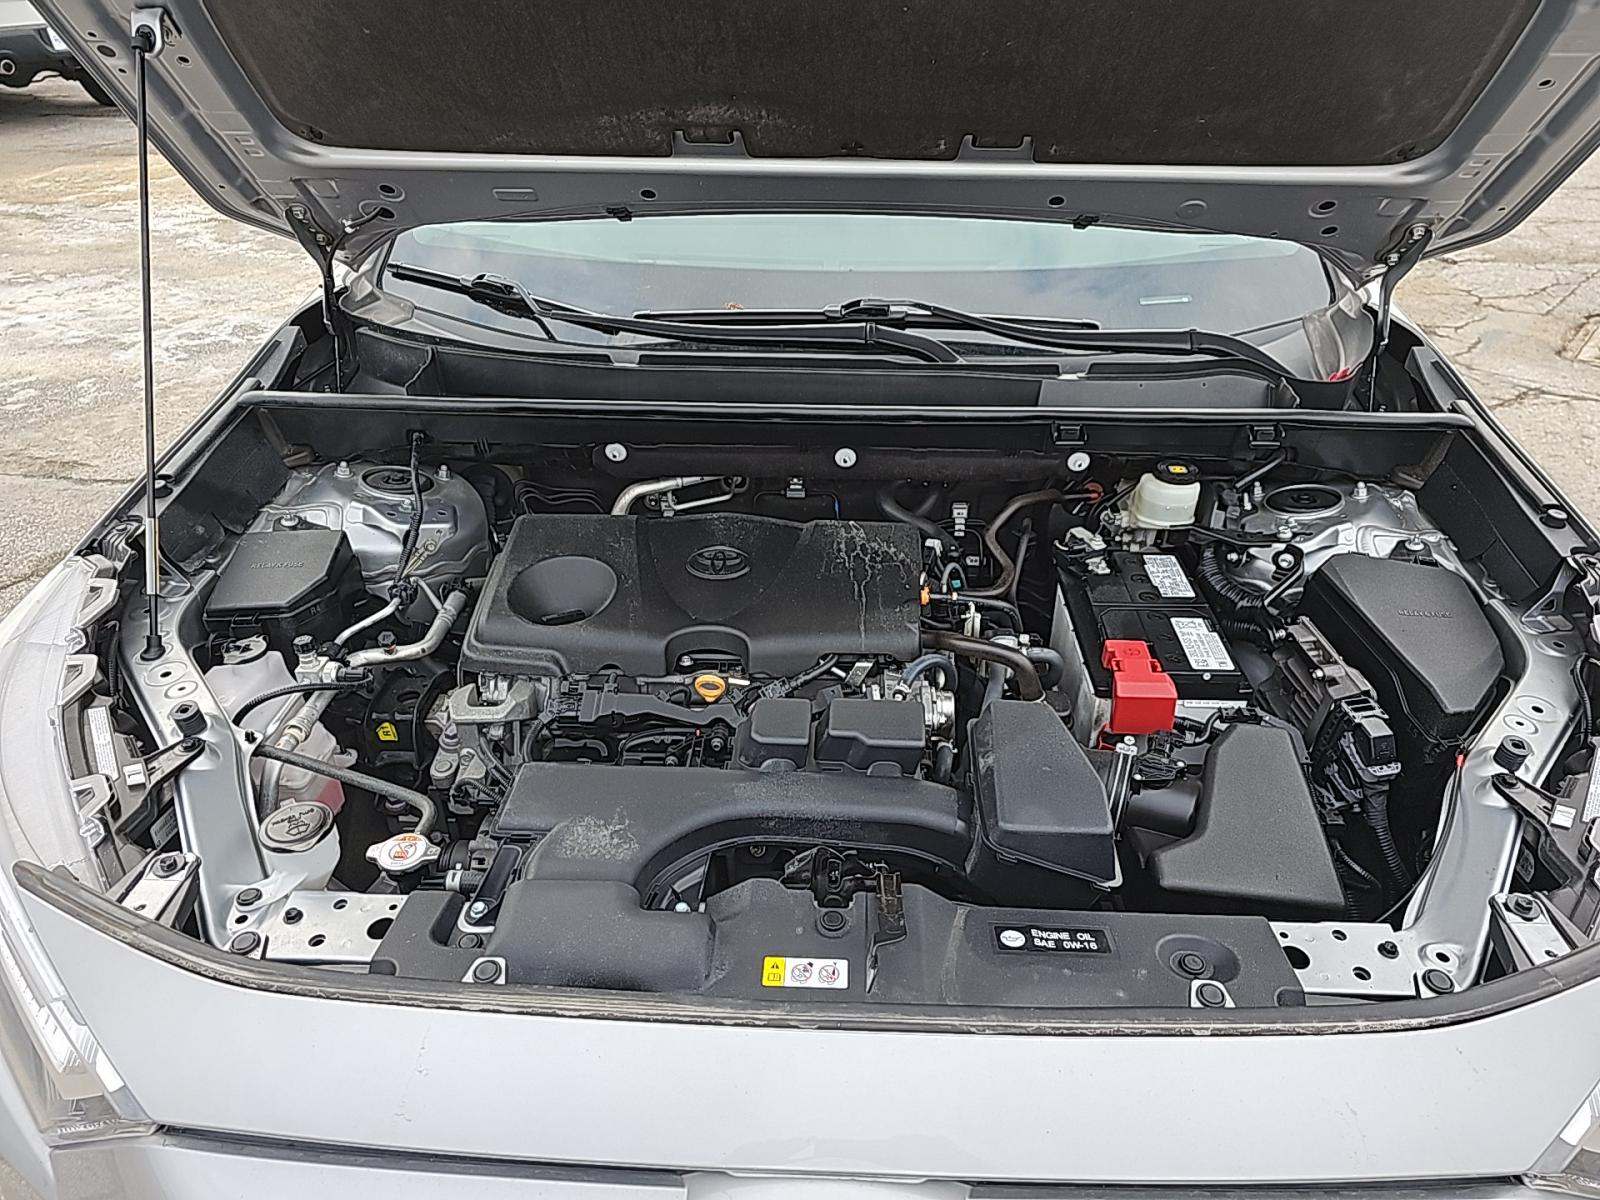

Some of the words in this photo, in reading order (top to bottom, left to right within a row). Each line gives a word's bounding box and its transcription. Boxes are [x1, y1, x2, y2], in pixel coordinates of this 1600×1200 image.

[1030, 928, 1071, 940] ENGINE
[1076, 932, 1096, 941] OIL
[1033, 938, 1057, 948] SAE
